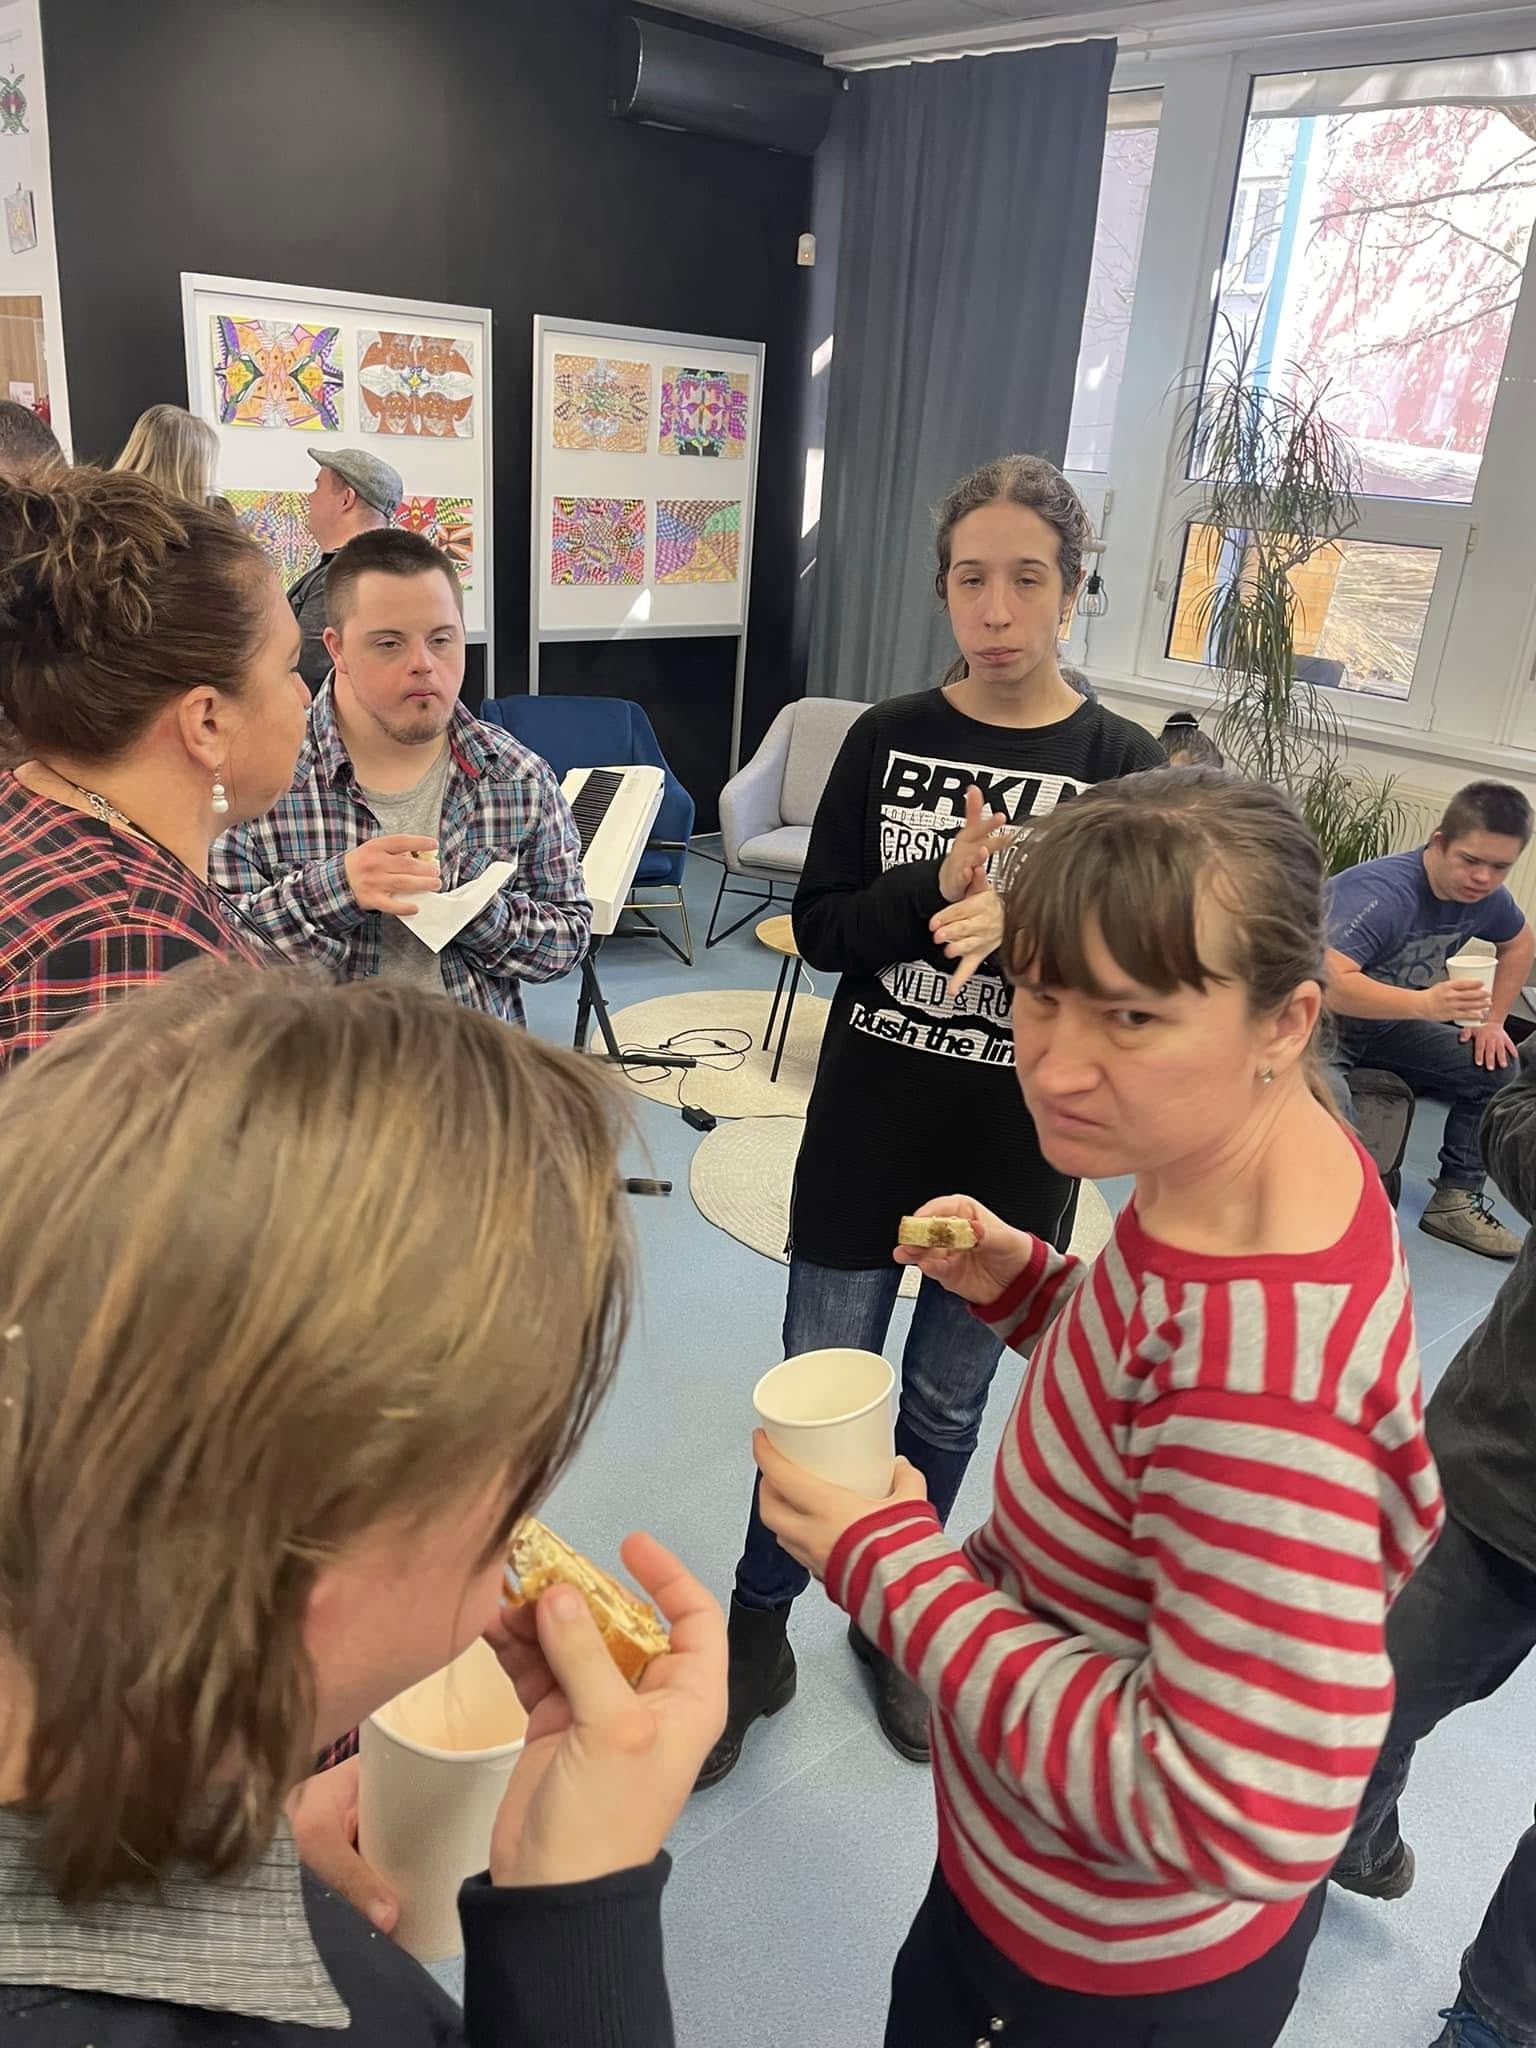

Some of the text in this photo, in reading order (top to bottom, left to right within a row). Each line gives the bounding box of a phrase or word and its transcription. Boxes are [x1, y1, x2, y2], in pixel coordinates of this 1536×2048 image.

[893, 966, 1012, 1018] WLD & RG
[852, 1007, 1015, 1065] push the lin
